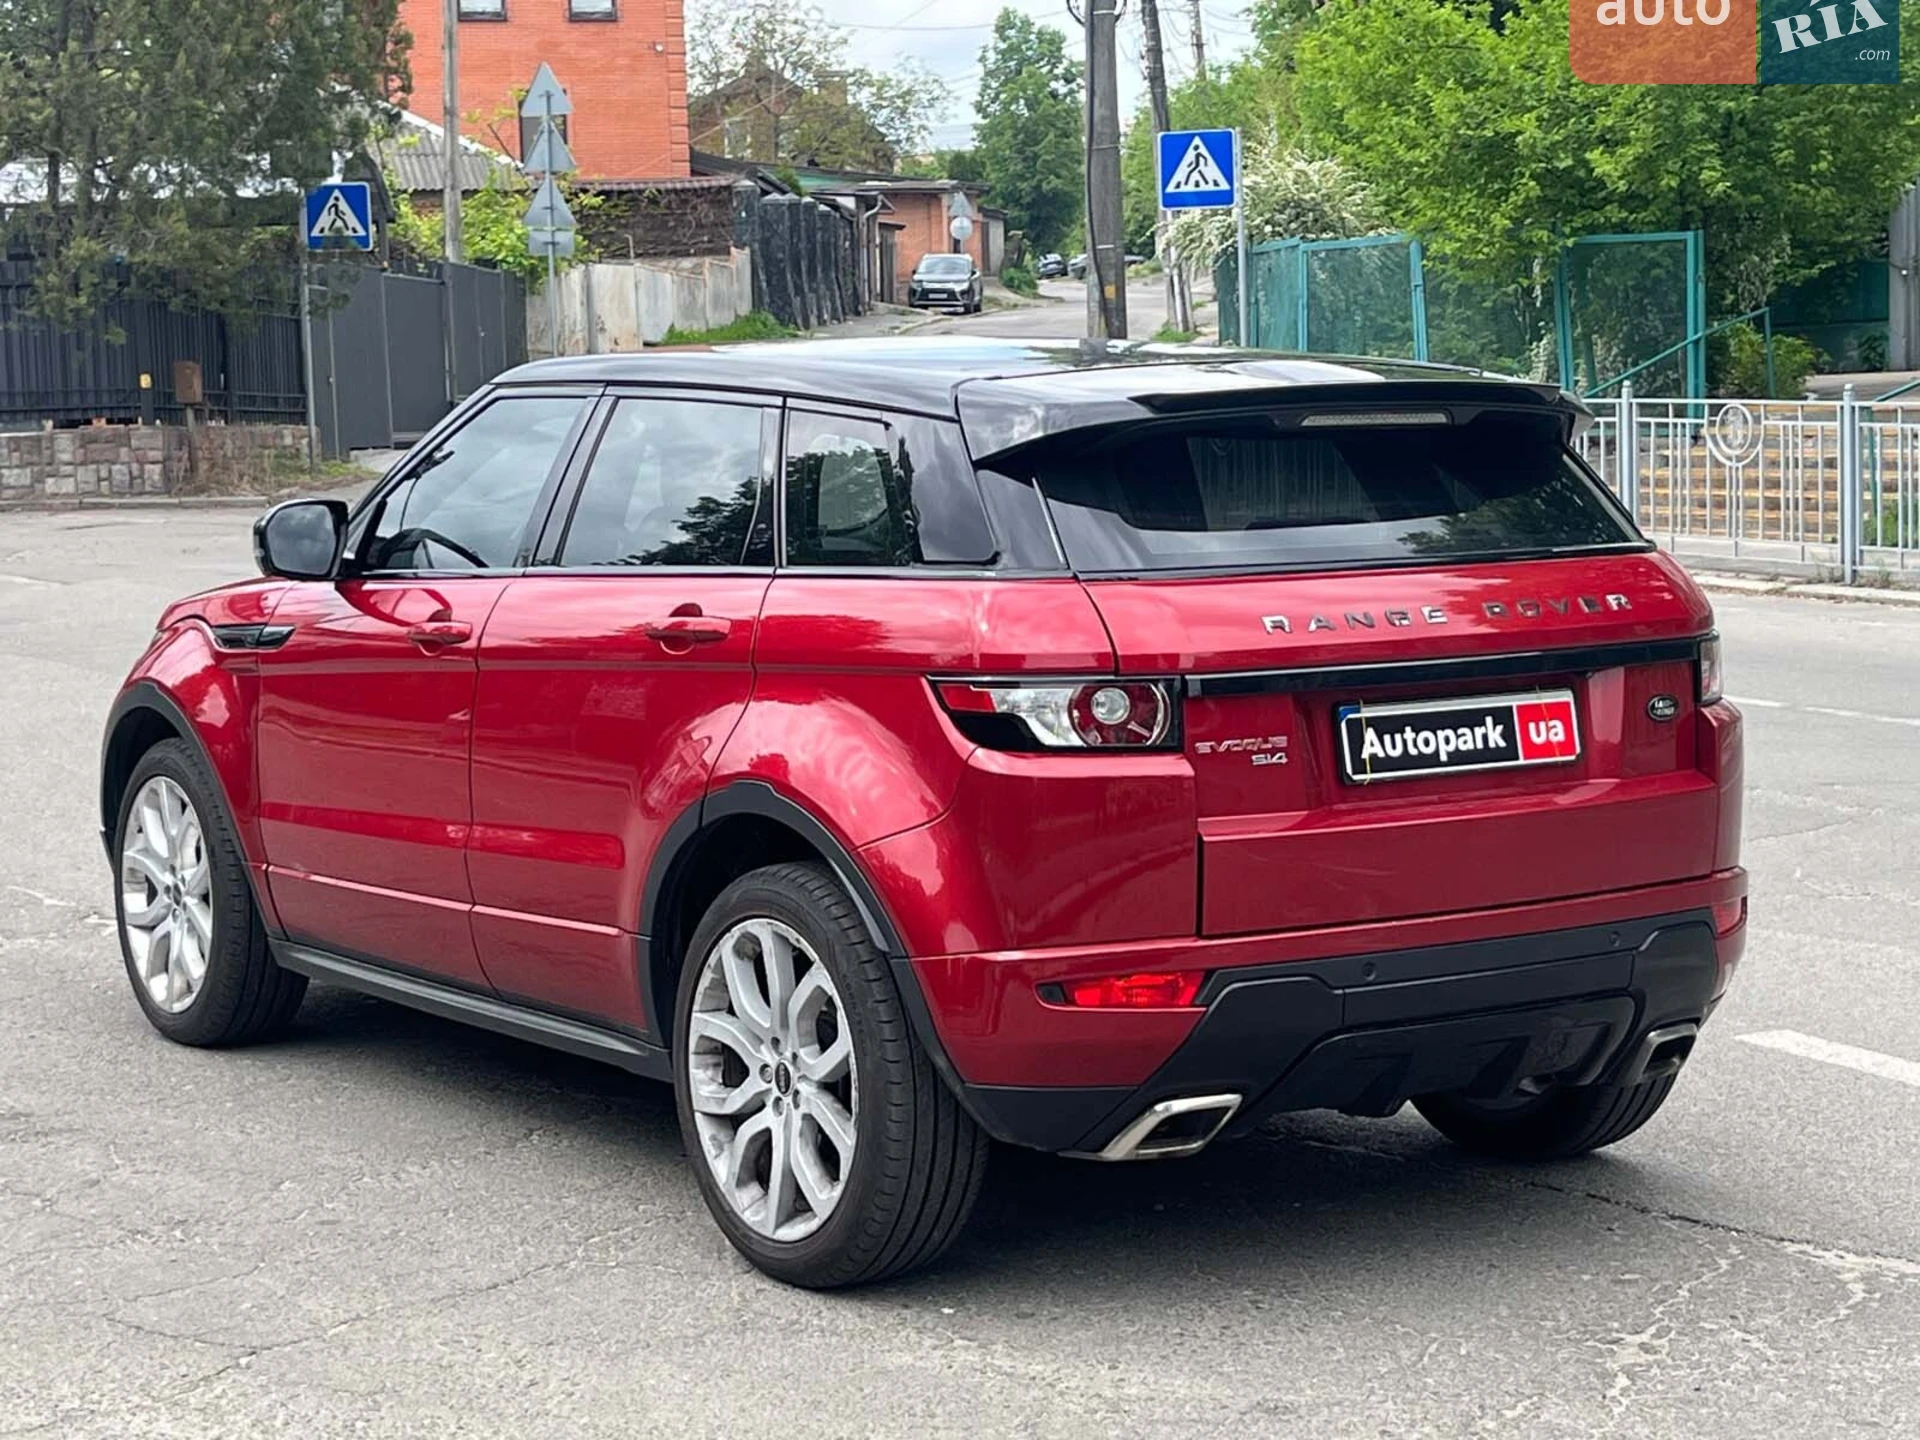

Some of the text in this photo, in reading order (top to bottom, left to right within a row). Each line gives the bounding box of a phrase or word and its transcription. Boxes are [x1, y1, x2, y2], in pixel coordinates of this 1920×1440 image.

[1260, 594, 1633, 635] RANGE ROVER
[1194, 736, 1288, 754] EVOQUE
[1361, 716, 1566, 762] Autopark ua
